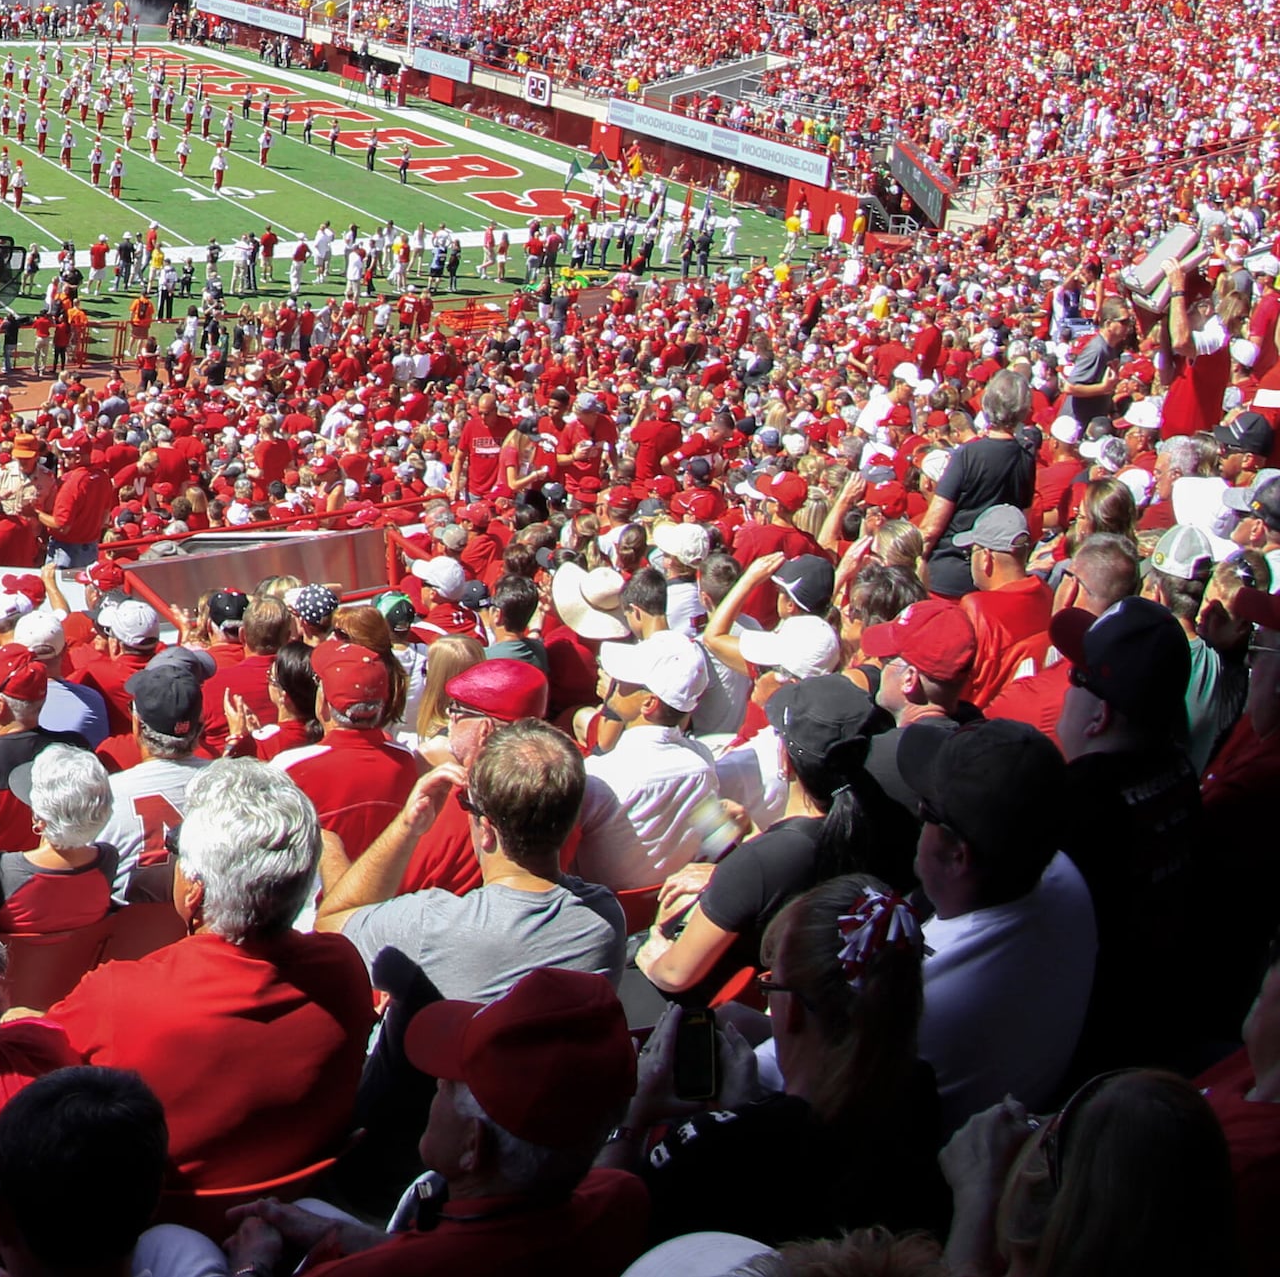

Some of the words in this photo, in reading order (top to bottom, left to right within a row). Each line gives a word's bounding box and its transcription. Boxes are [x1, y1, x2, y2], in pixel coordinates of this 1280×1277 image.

[530, 77, 546, 100] 25
[78, 45, 625, 220] HUSKERS
[635, 111, 708, 144] WOODHOUSE.COM
[741, 143, 824, 177] WOODHOUSE.COM
